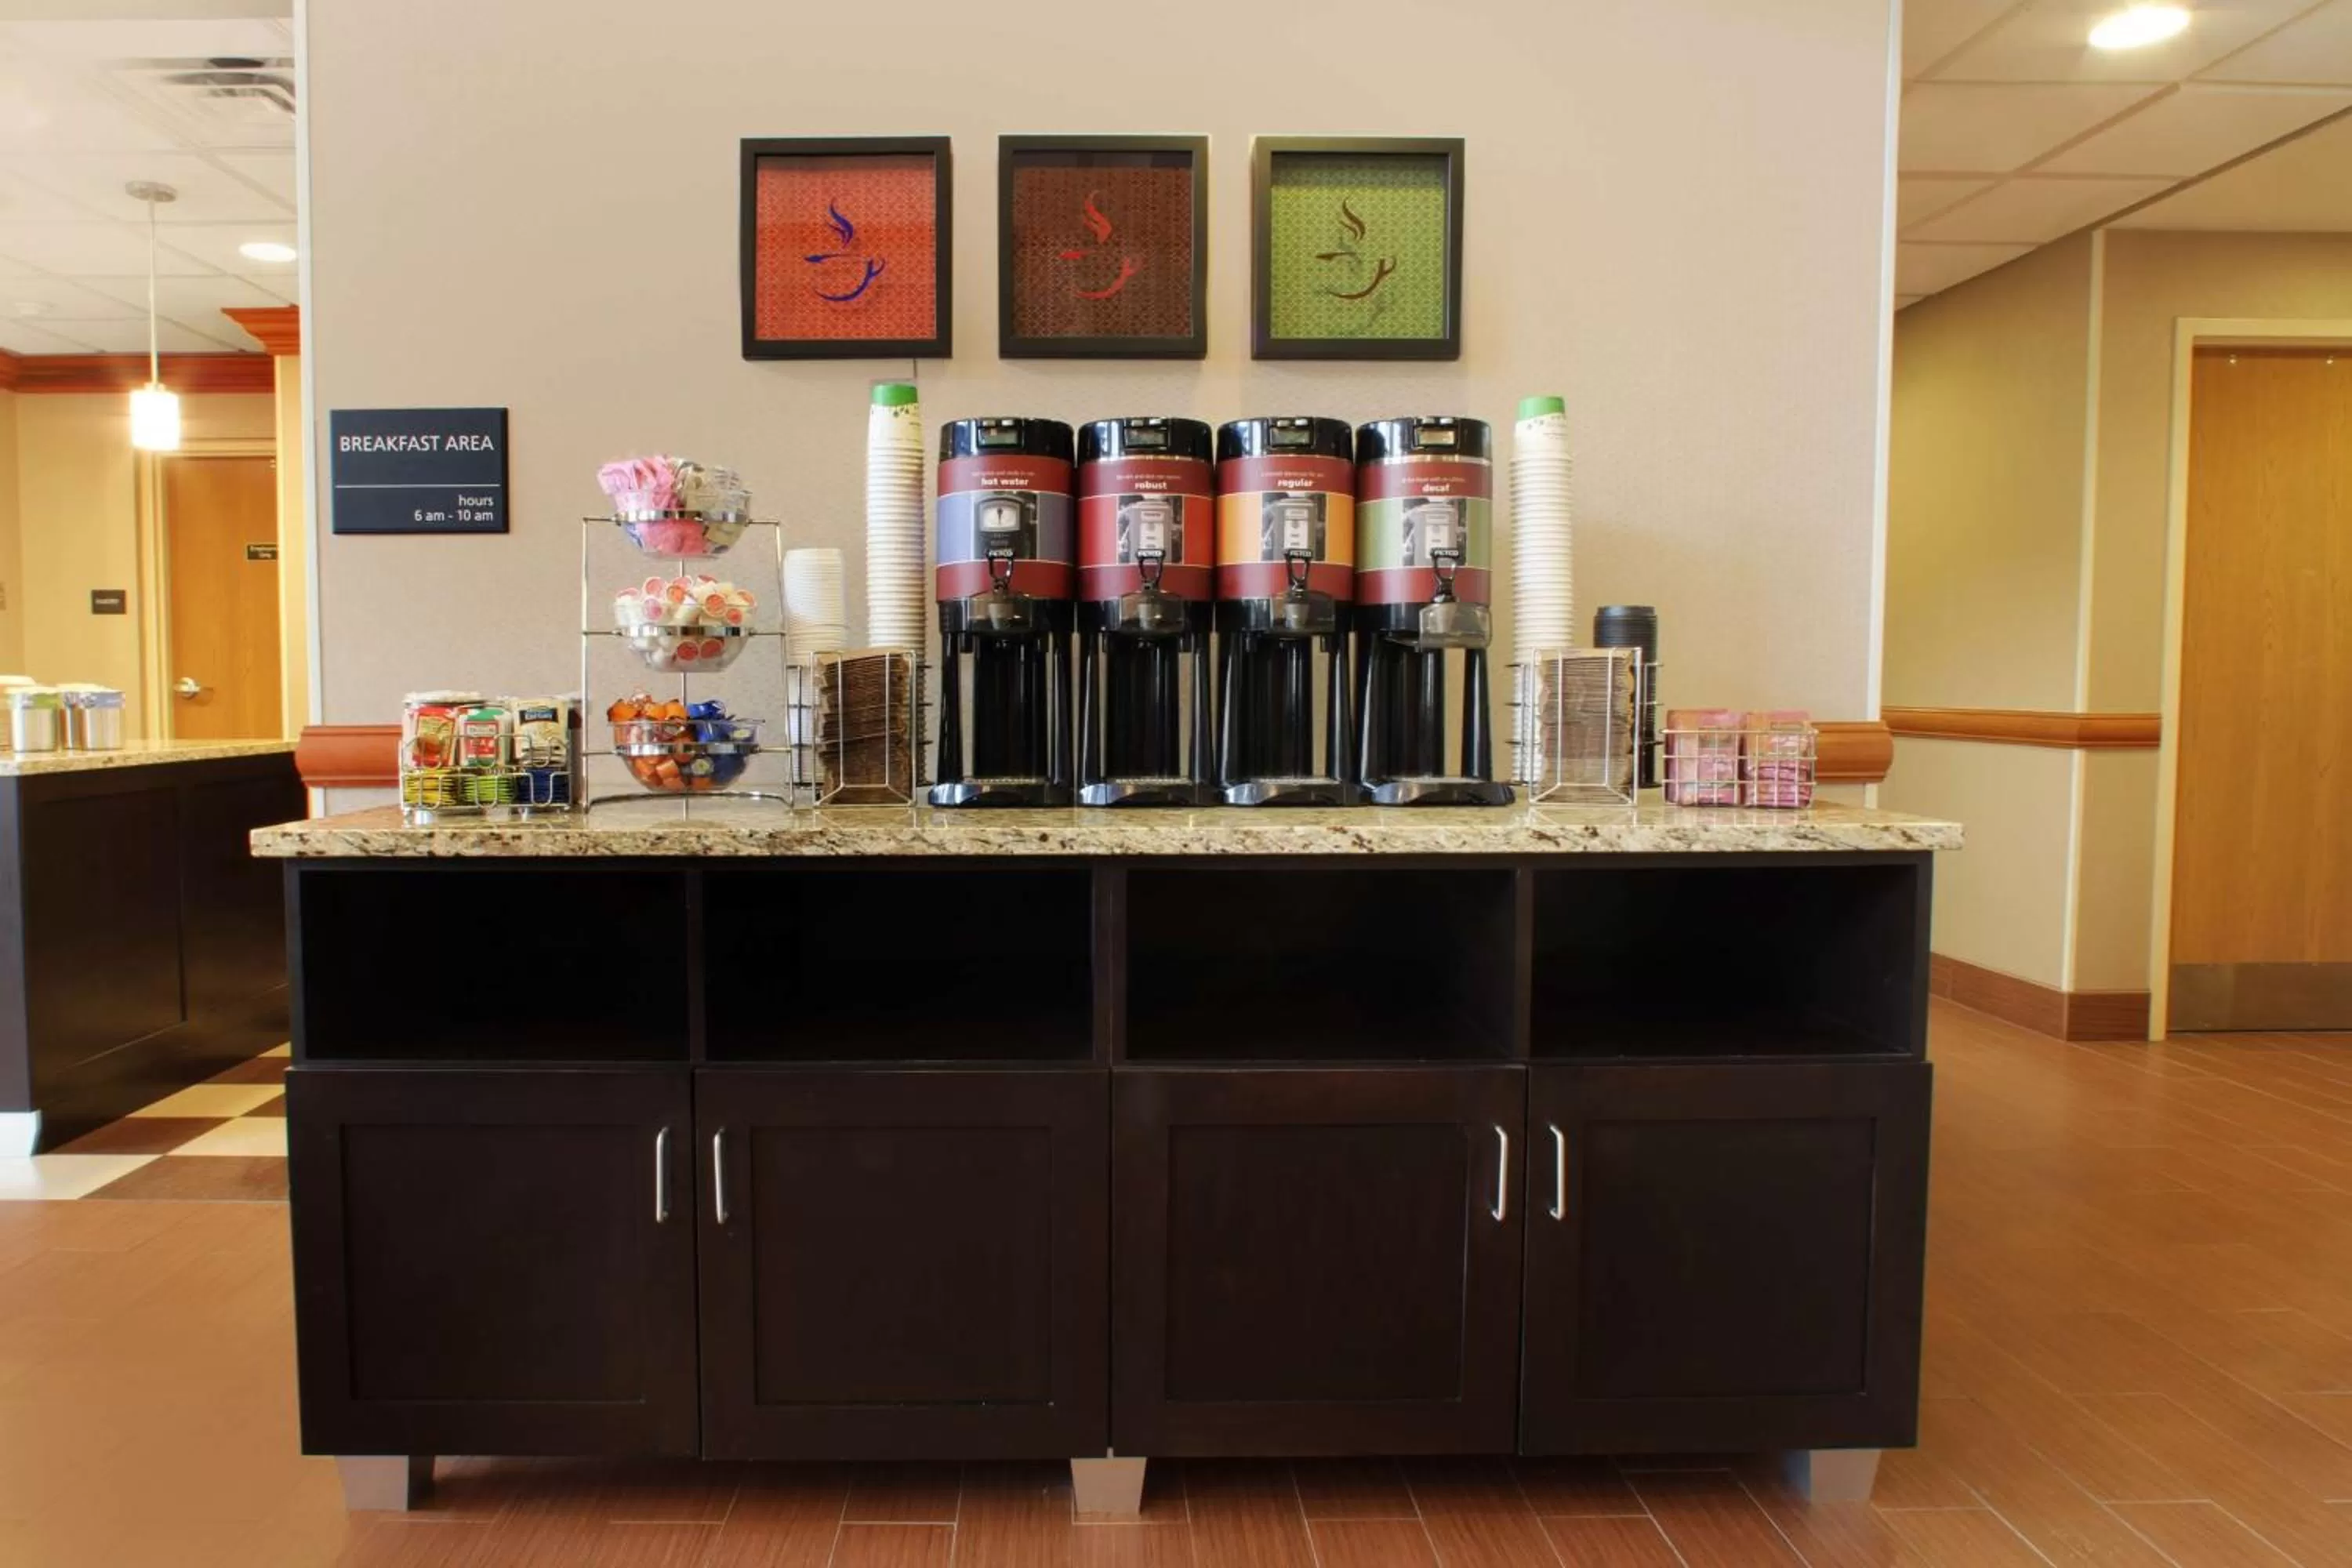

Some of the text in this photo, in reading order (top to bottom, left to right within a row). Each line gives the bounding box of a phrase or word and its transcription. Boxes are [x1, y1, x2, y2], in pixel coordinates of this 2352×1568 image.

[339, 434, 494, 452] BREAKFAST AREA
[981, 477, 1029, 486] hot water
[1134, 481, 1167, 489] robust
[1277, 478, 1314, 488] regular
[1421, 483, 1450, 492] decaf
[458, 494, 494, 506] hours
[414, 510, 423, 521] 6
[425, 512, 445, 521] am
[458, 510, 471, 521] 10
[474, 511, 494, 521] am
